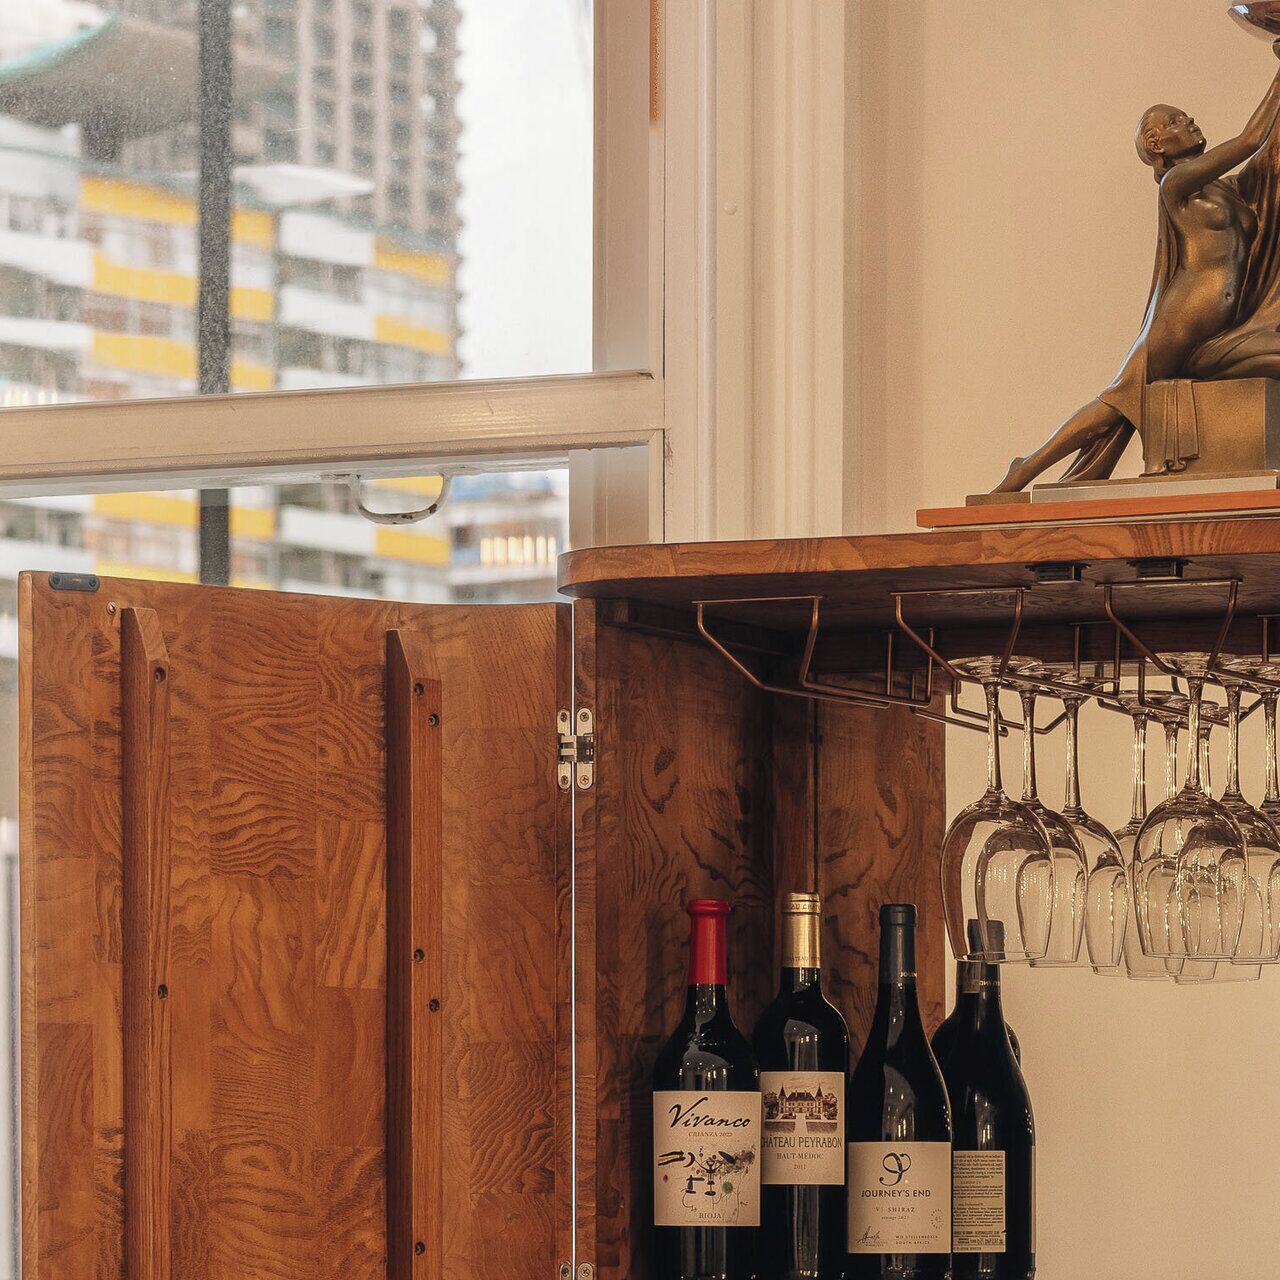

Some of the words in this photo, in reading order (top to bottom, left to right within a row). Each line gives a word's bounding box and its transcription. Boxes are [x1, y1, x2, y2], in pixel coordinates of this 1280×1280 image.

[668, 1097, 751, 1128] Vivanco
[798, 1136, 842, 1148] PEYRABON
[776, 1151, 824, 1160] HAUT-MÉDOC
[861, 1189, 910, 1198] JOURNEY'S
[913, 1189, 931, 1198] END
